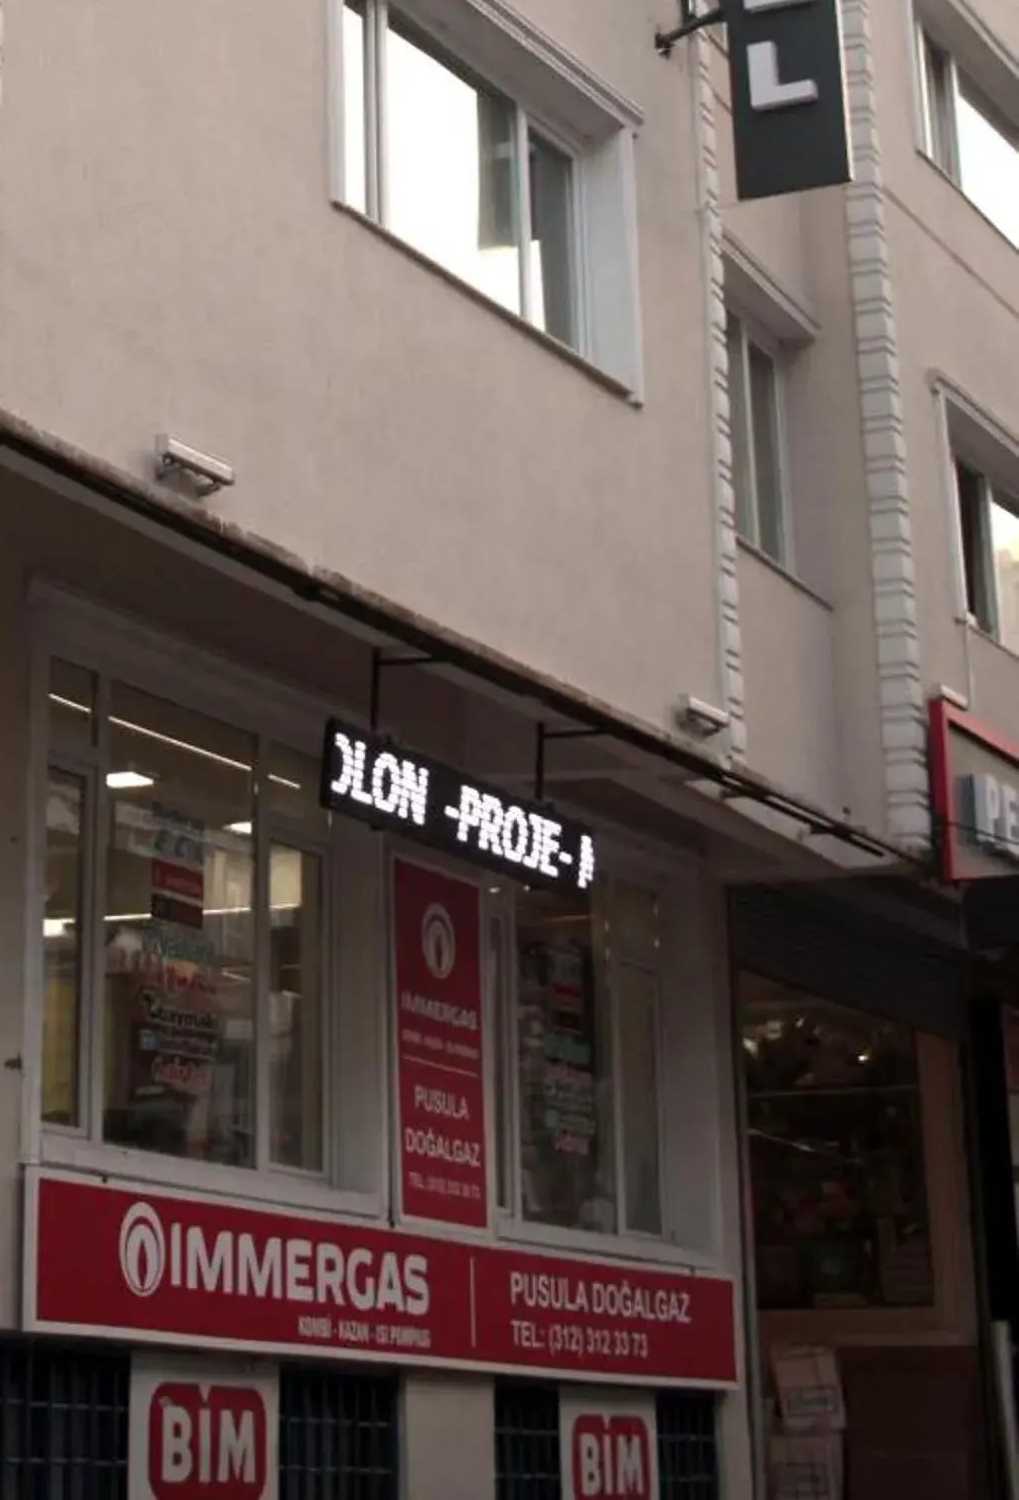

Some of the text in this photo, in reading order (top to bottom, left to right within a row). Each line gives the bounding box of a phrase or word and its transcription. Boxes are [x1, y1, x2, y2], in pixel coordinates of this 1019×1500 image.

[414, 1084, 469, 1120] PUSULA
[404, 1127, 481, 1168] DOĞALGAZ
[170, 1221, 430, 1316] IMMERGAS
[510, 1271, 692, 1324] PUSULA DOĞALGAZ
